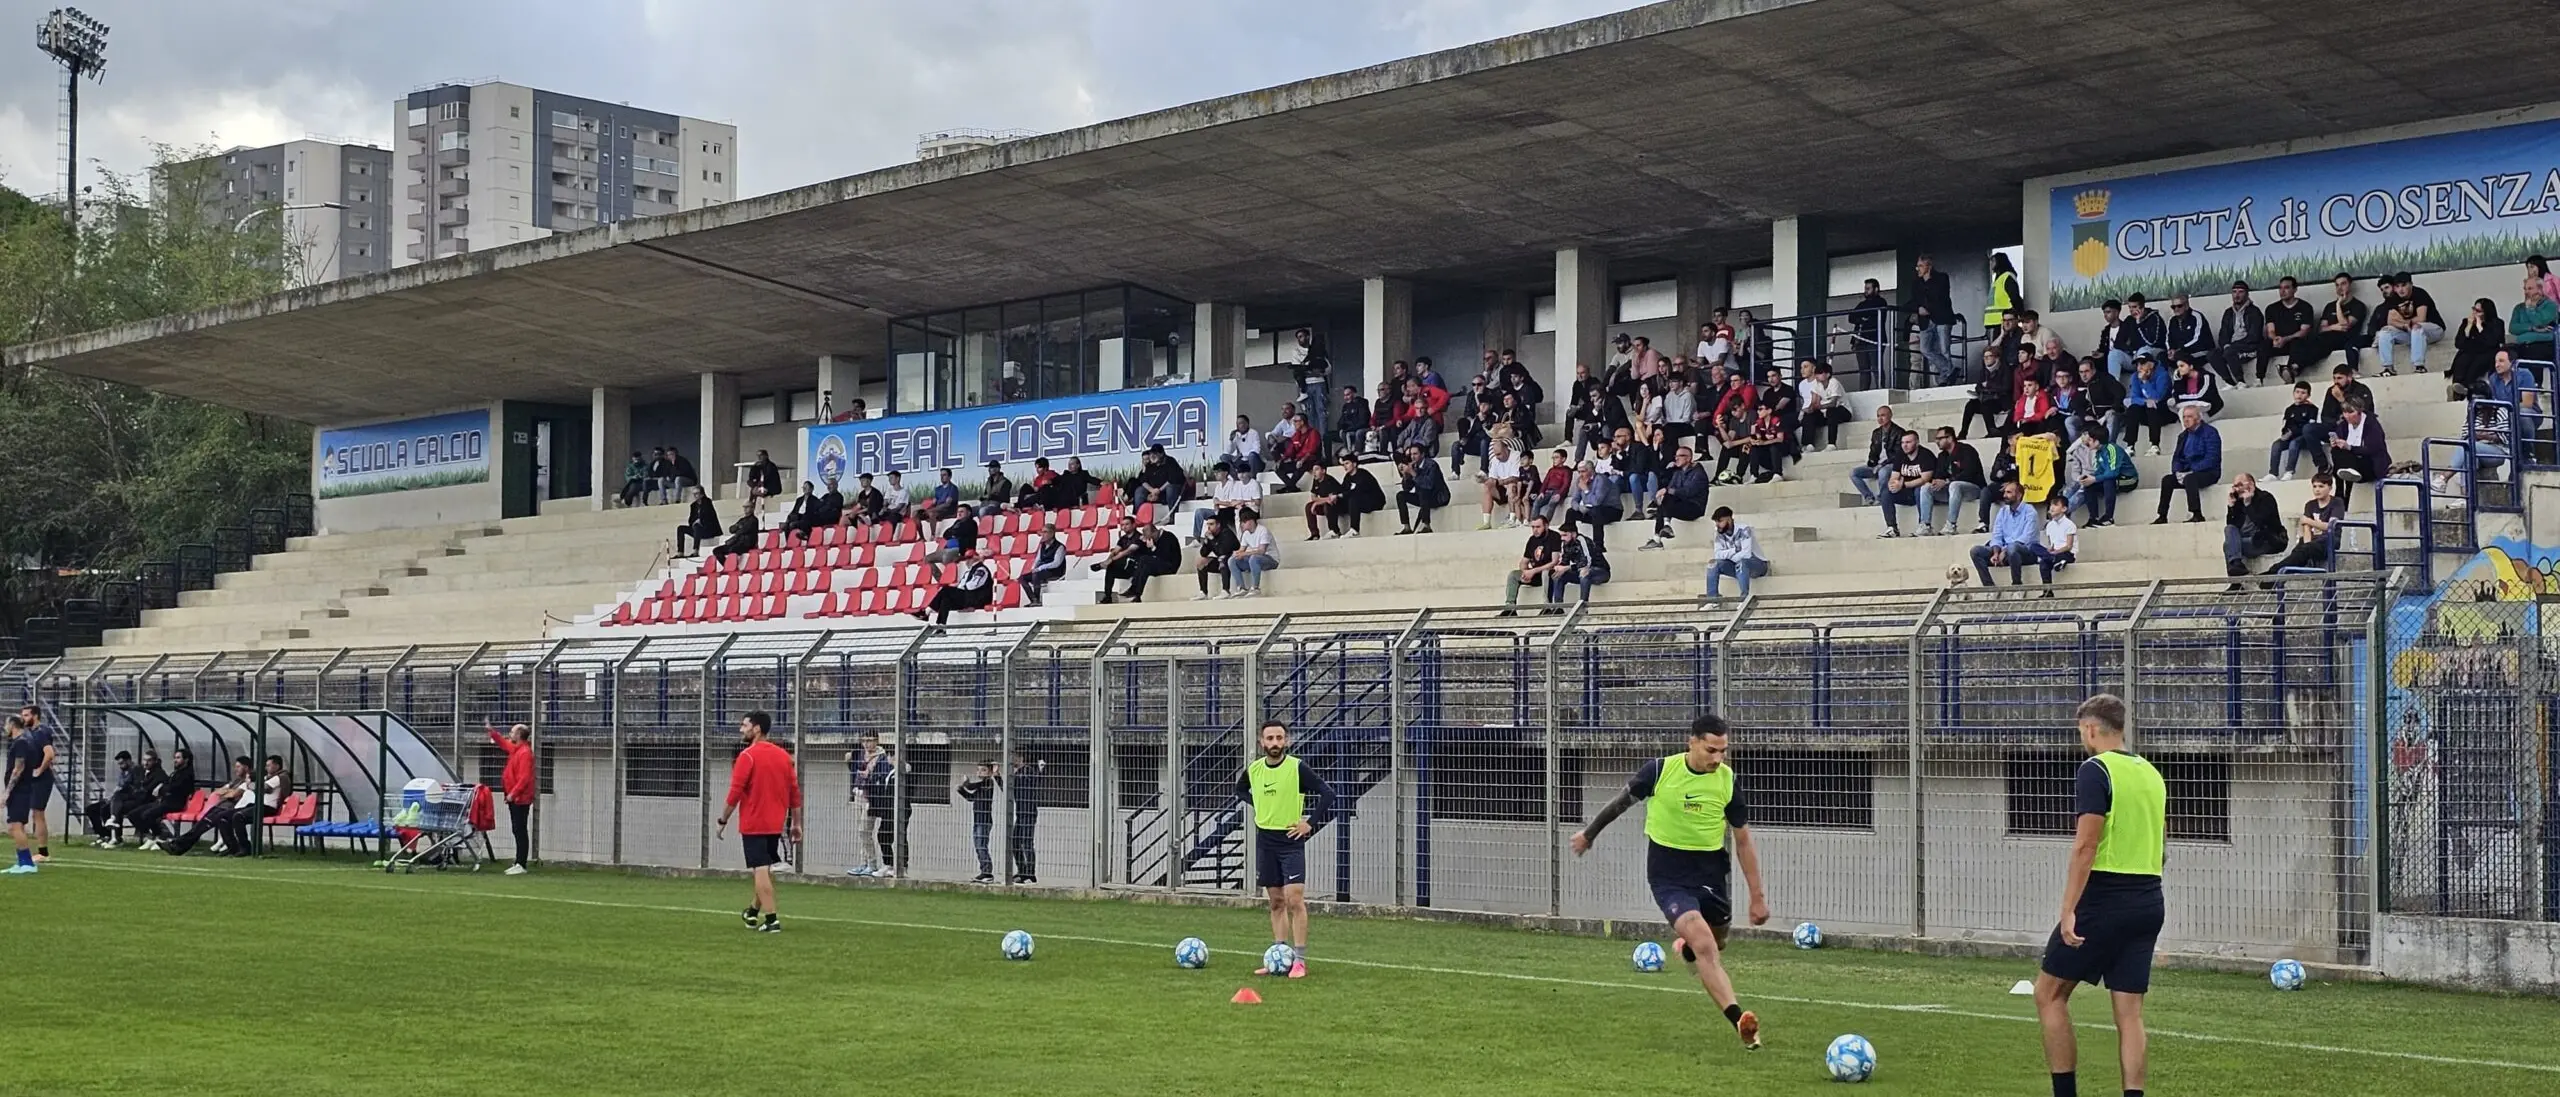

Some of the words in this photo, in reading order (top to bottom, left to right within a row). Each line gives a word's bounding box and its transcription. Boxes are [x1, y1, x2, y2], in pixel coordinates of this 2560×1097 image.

[2115, 197, 2261, 261] CITTÁ
[2268, 197, 2309, 243] di
[2319, 167, 2560, 237] COSENZA
[337, 440, 409, 475] SCUOLA
[414, 428, 482, 465] CALCIO
[854, 424, 966, 477] REAL
[977, 396, 1209, 467] COSENZA
[2028, 454, 2036, 476] 1
